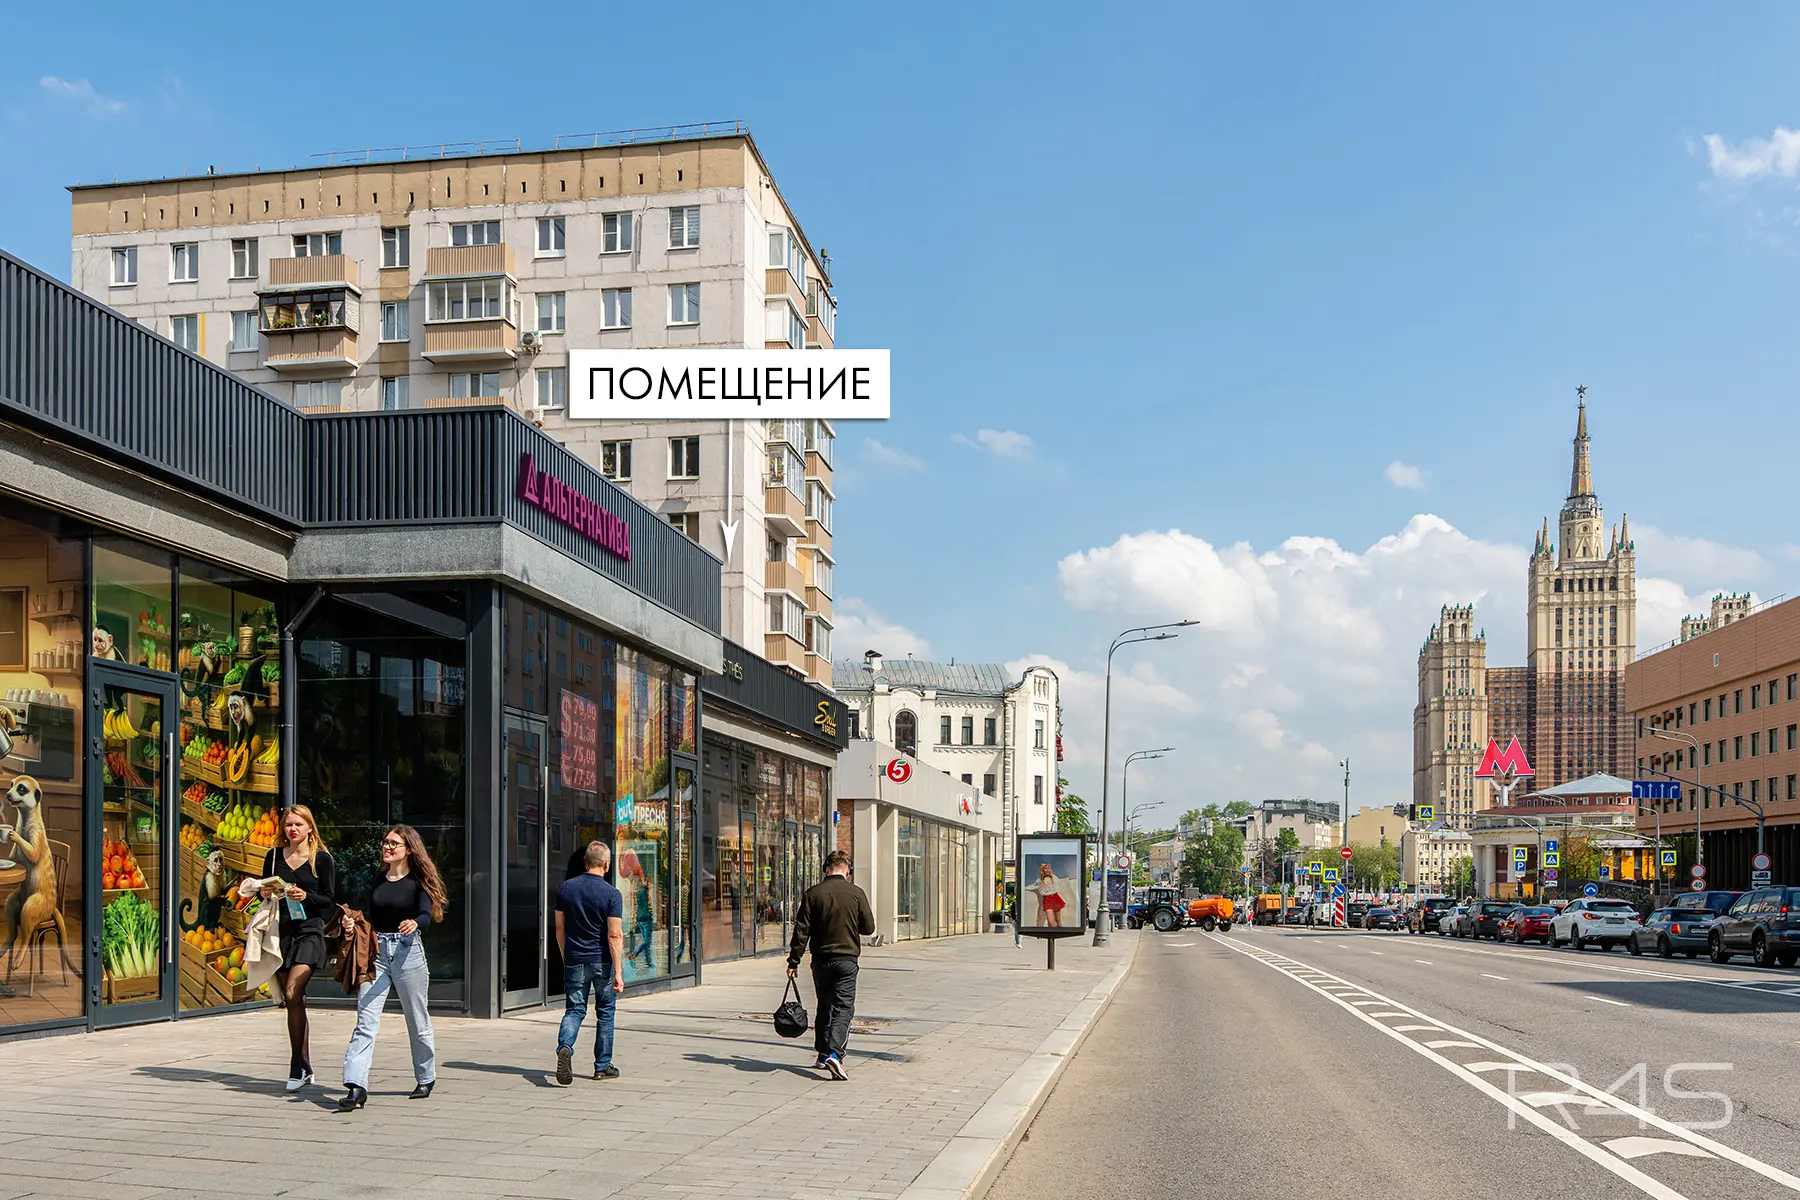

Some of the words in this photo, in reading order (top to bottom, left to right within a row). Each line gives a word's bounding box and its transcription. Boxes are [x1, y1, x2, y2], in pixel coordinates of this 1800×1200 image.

[543, 471, 631, 561] АЛЬТЕРНАТИВА
[634, 805, 666, 826] ПРЕСНЯ
[1518, 862, 1524, 871] P
